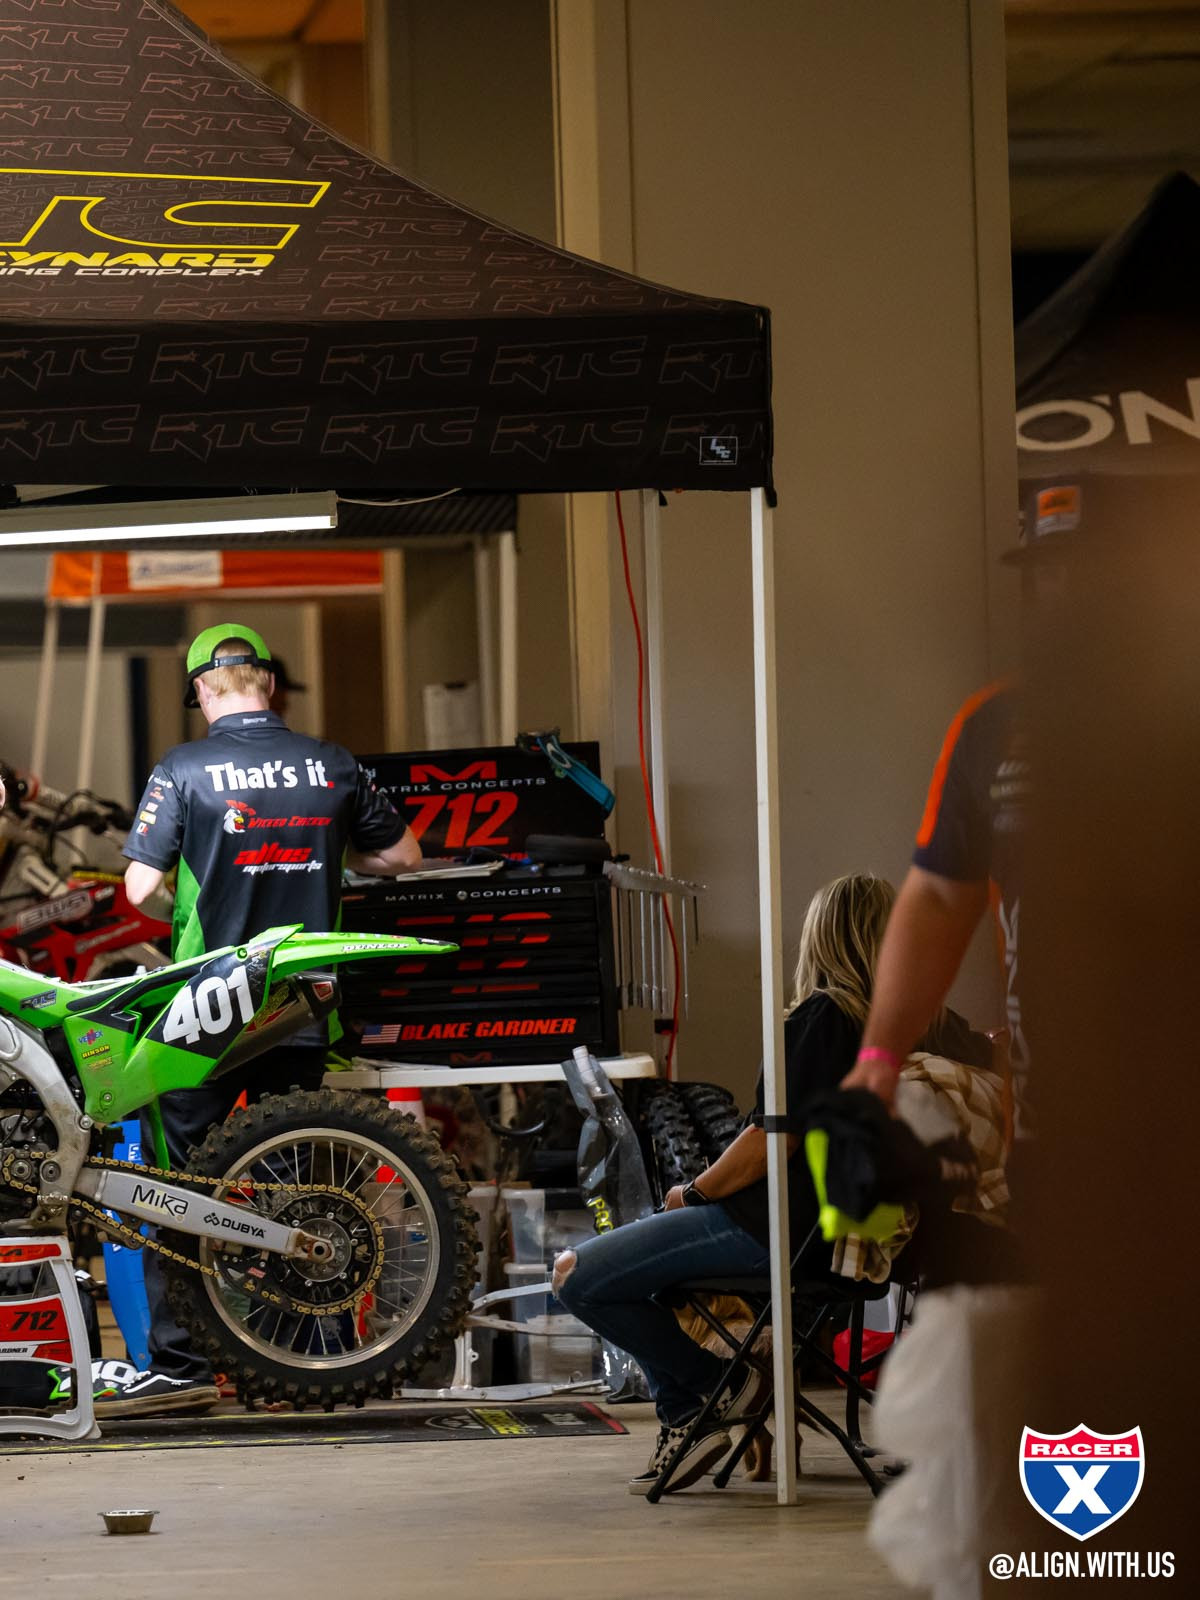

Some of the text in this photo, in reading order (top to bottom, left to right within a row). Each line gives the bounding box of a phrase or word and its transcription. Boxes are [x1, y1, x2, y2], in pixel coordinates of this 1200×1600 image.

[75, 268, 263, 277] COMPLEX
[205, 758, 335, 792] That's it.
[377, 777, 546, 794] ATRIX CONCEPTS
[404, 791, 519, 849] 712
[385, 886, 561, 902] MATRIX CONCEPTS
[162, 964, 255, 1045] 401
[401, 1018, 577, 1041] BLAKE GARDNER
[221, 1218, 266, 1239] DUBYA
[10, 1310, 58, 1331] 712
